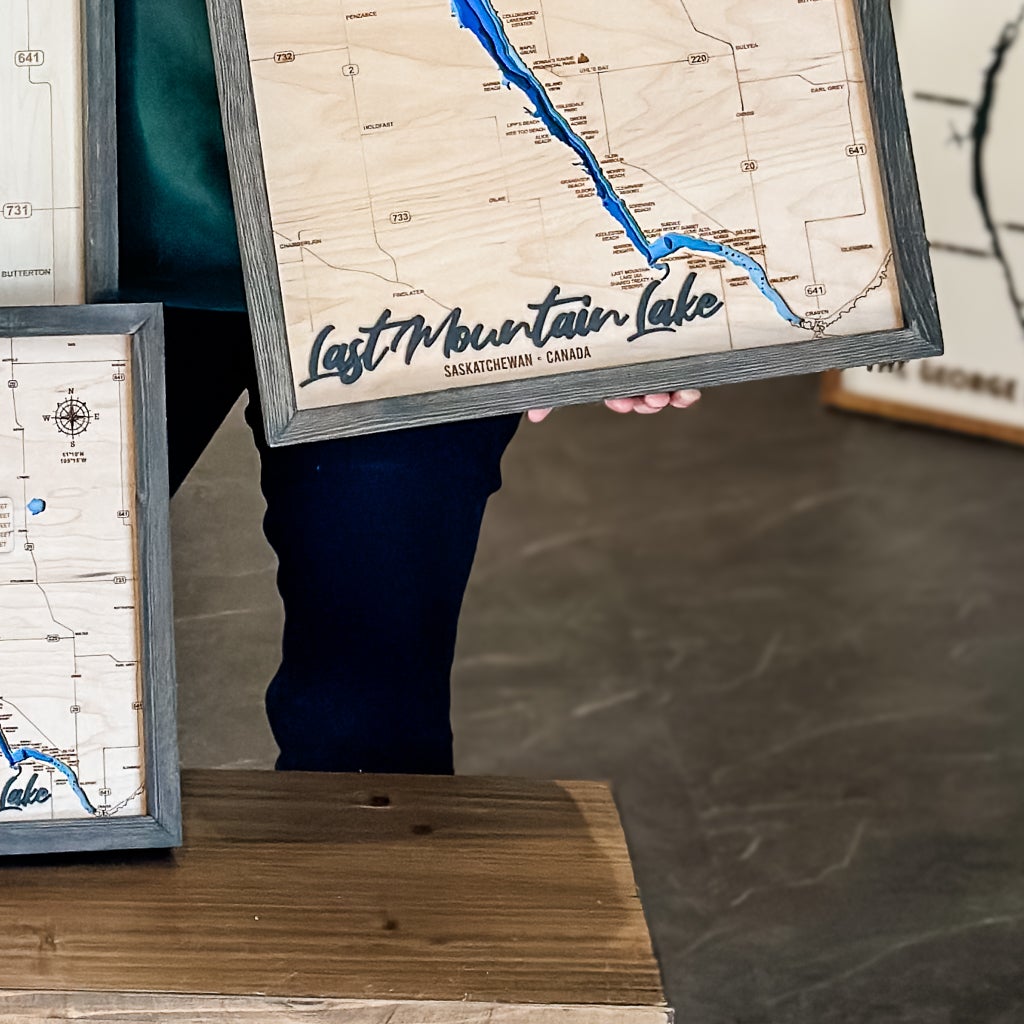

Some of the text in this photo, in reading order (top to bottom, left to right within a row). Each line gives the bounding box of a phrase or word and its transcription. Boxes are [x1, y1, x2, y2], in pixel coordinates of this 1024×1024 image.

[18, 52, 40, 63] 641
[276, 52, 292, 61] 732
[690, 54, 707, 64] 220
[848, 145, 864, 155] 641
[744, 162, 755, 170] 20
[6, 204, 28, 216] 731
[392, 213, 409, 222] 733
[2, 269, 50, 277] BUTTERTON
[807, 286, 823, 295] 641
[299, 272, 724, 388] Last Mountain Lake
[444, 346, 592, 378] SASKATCHEWAN CANADA
